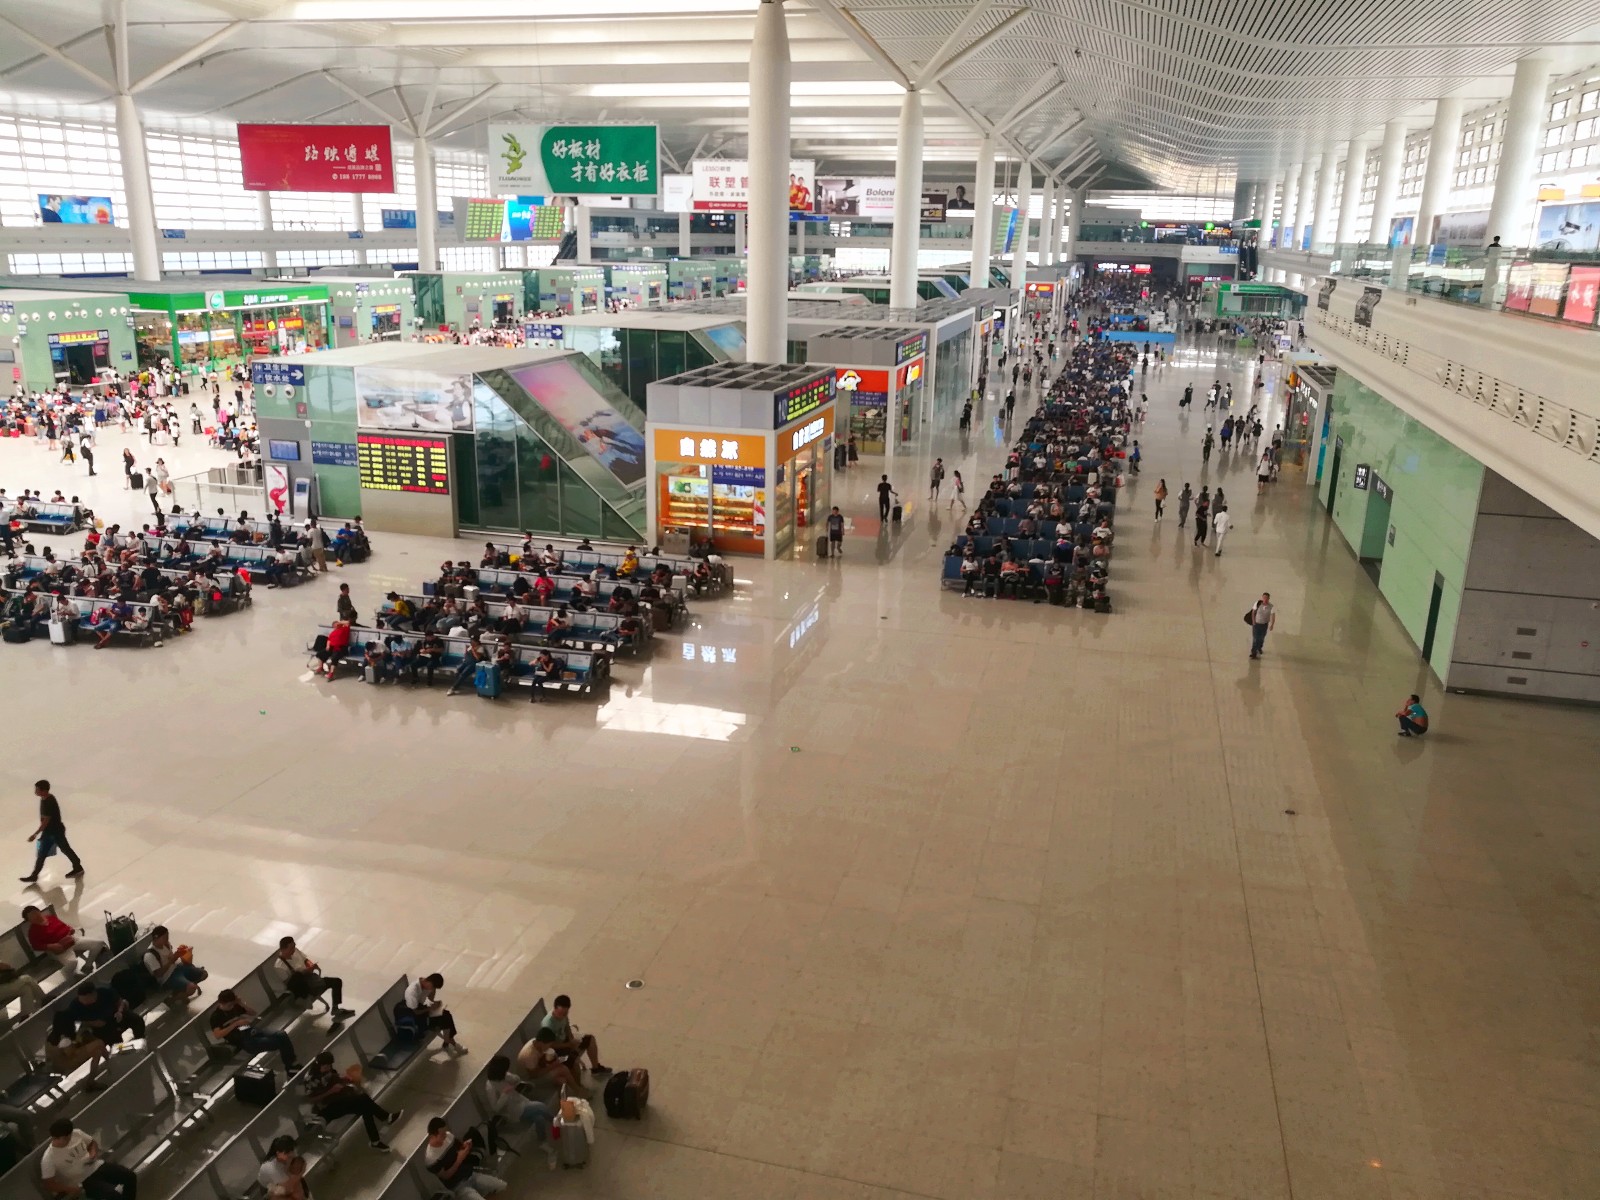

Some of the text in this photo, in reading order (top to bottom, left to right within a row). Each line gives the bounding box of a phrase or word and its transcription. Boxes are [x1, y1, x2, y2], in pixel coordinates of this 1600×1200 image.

[552, 138, 601, 160] 好板材
[571, 161, 649, 182] 才有好衣柜
[263, 363, 289, 372] 卫生间
[264, 373, 290, 383] 饮水处
